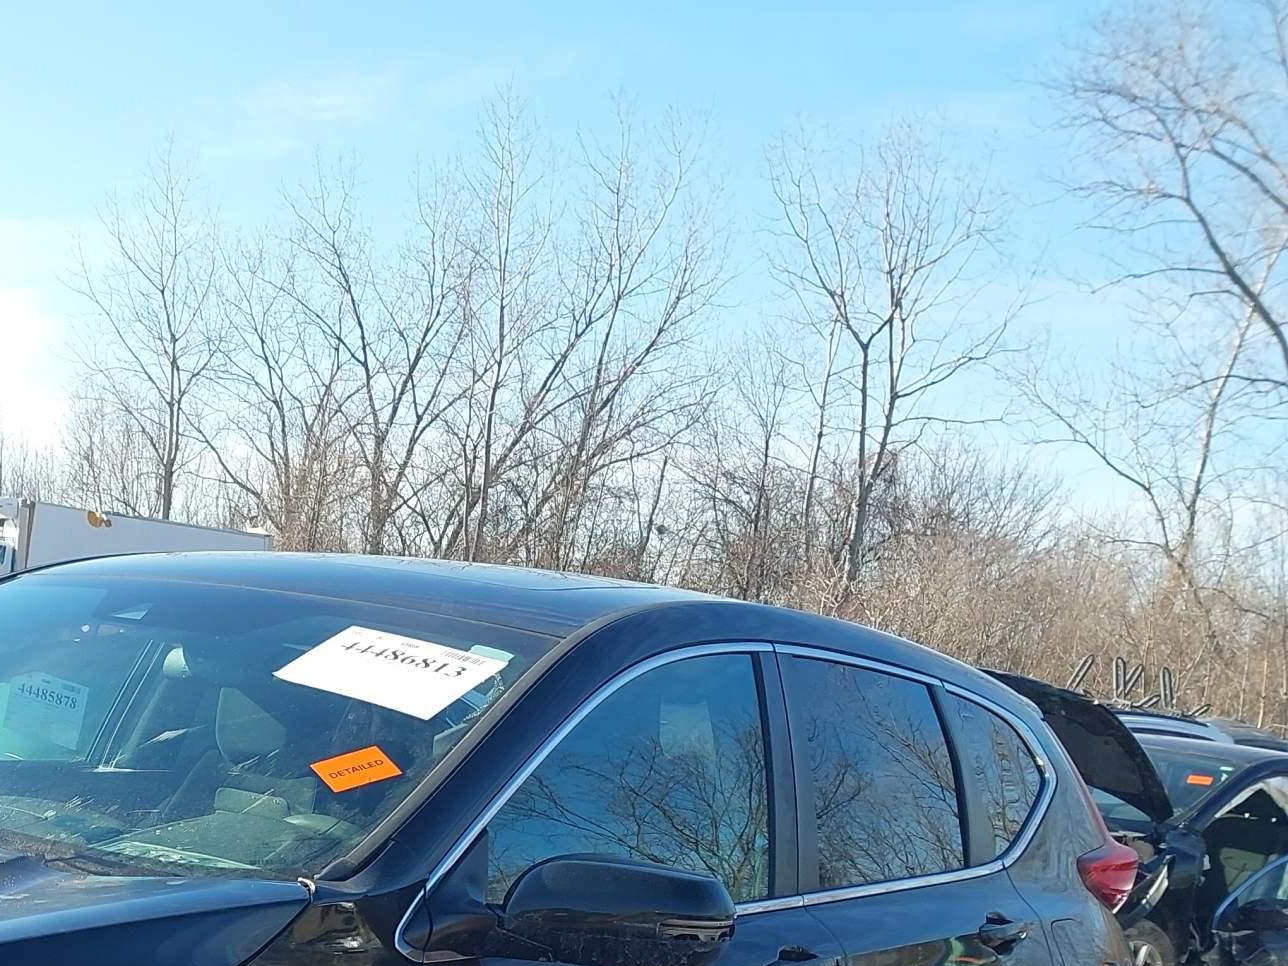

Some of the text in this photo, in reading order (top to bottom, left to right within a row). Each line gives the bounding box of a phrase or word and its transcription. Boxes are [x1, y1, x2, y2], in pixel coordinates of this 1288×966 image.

[340, 641, 467, 678] 44486813
[17, 683, 78, 710] 44485878
[328, 759, 384, 779] DETAILED
